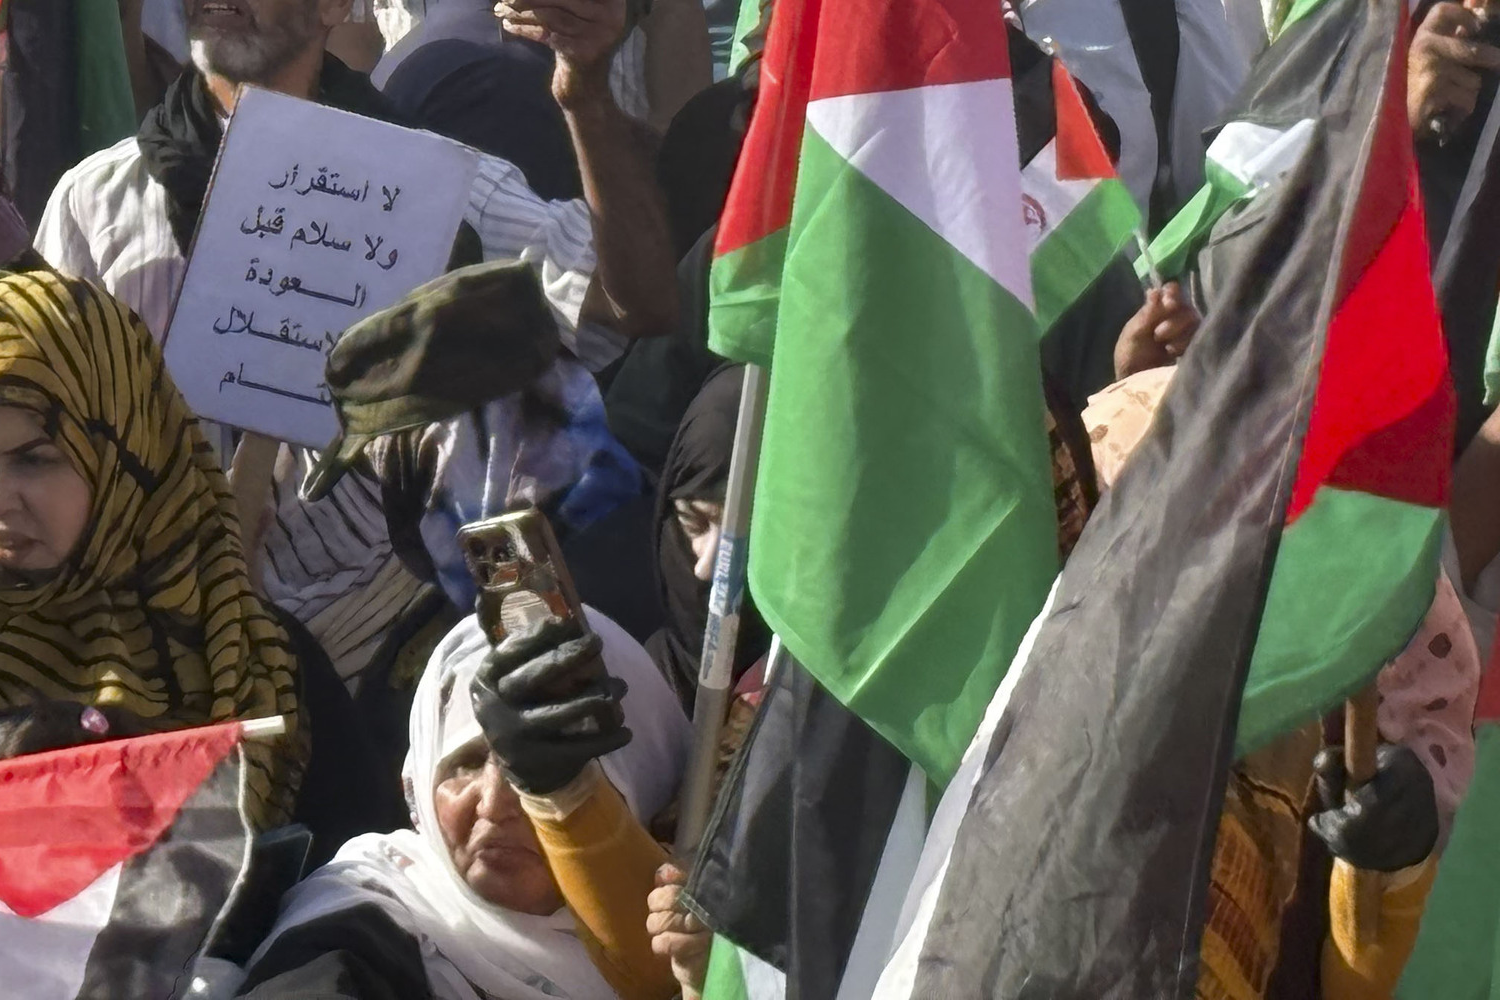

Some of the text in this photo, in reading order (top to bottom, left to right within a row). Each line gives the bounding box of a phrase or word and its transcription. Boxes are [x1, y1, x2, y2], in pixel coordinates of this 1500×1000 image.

[382, 186, 401, 212] لا
[240, 205, 398, 270] ولا سلام قبل
